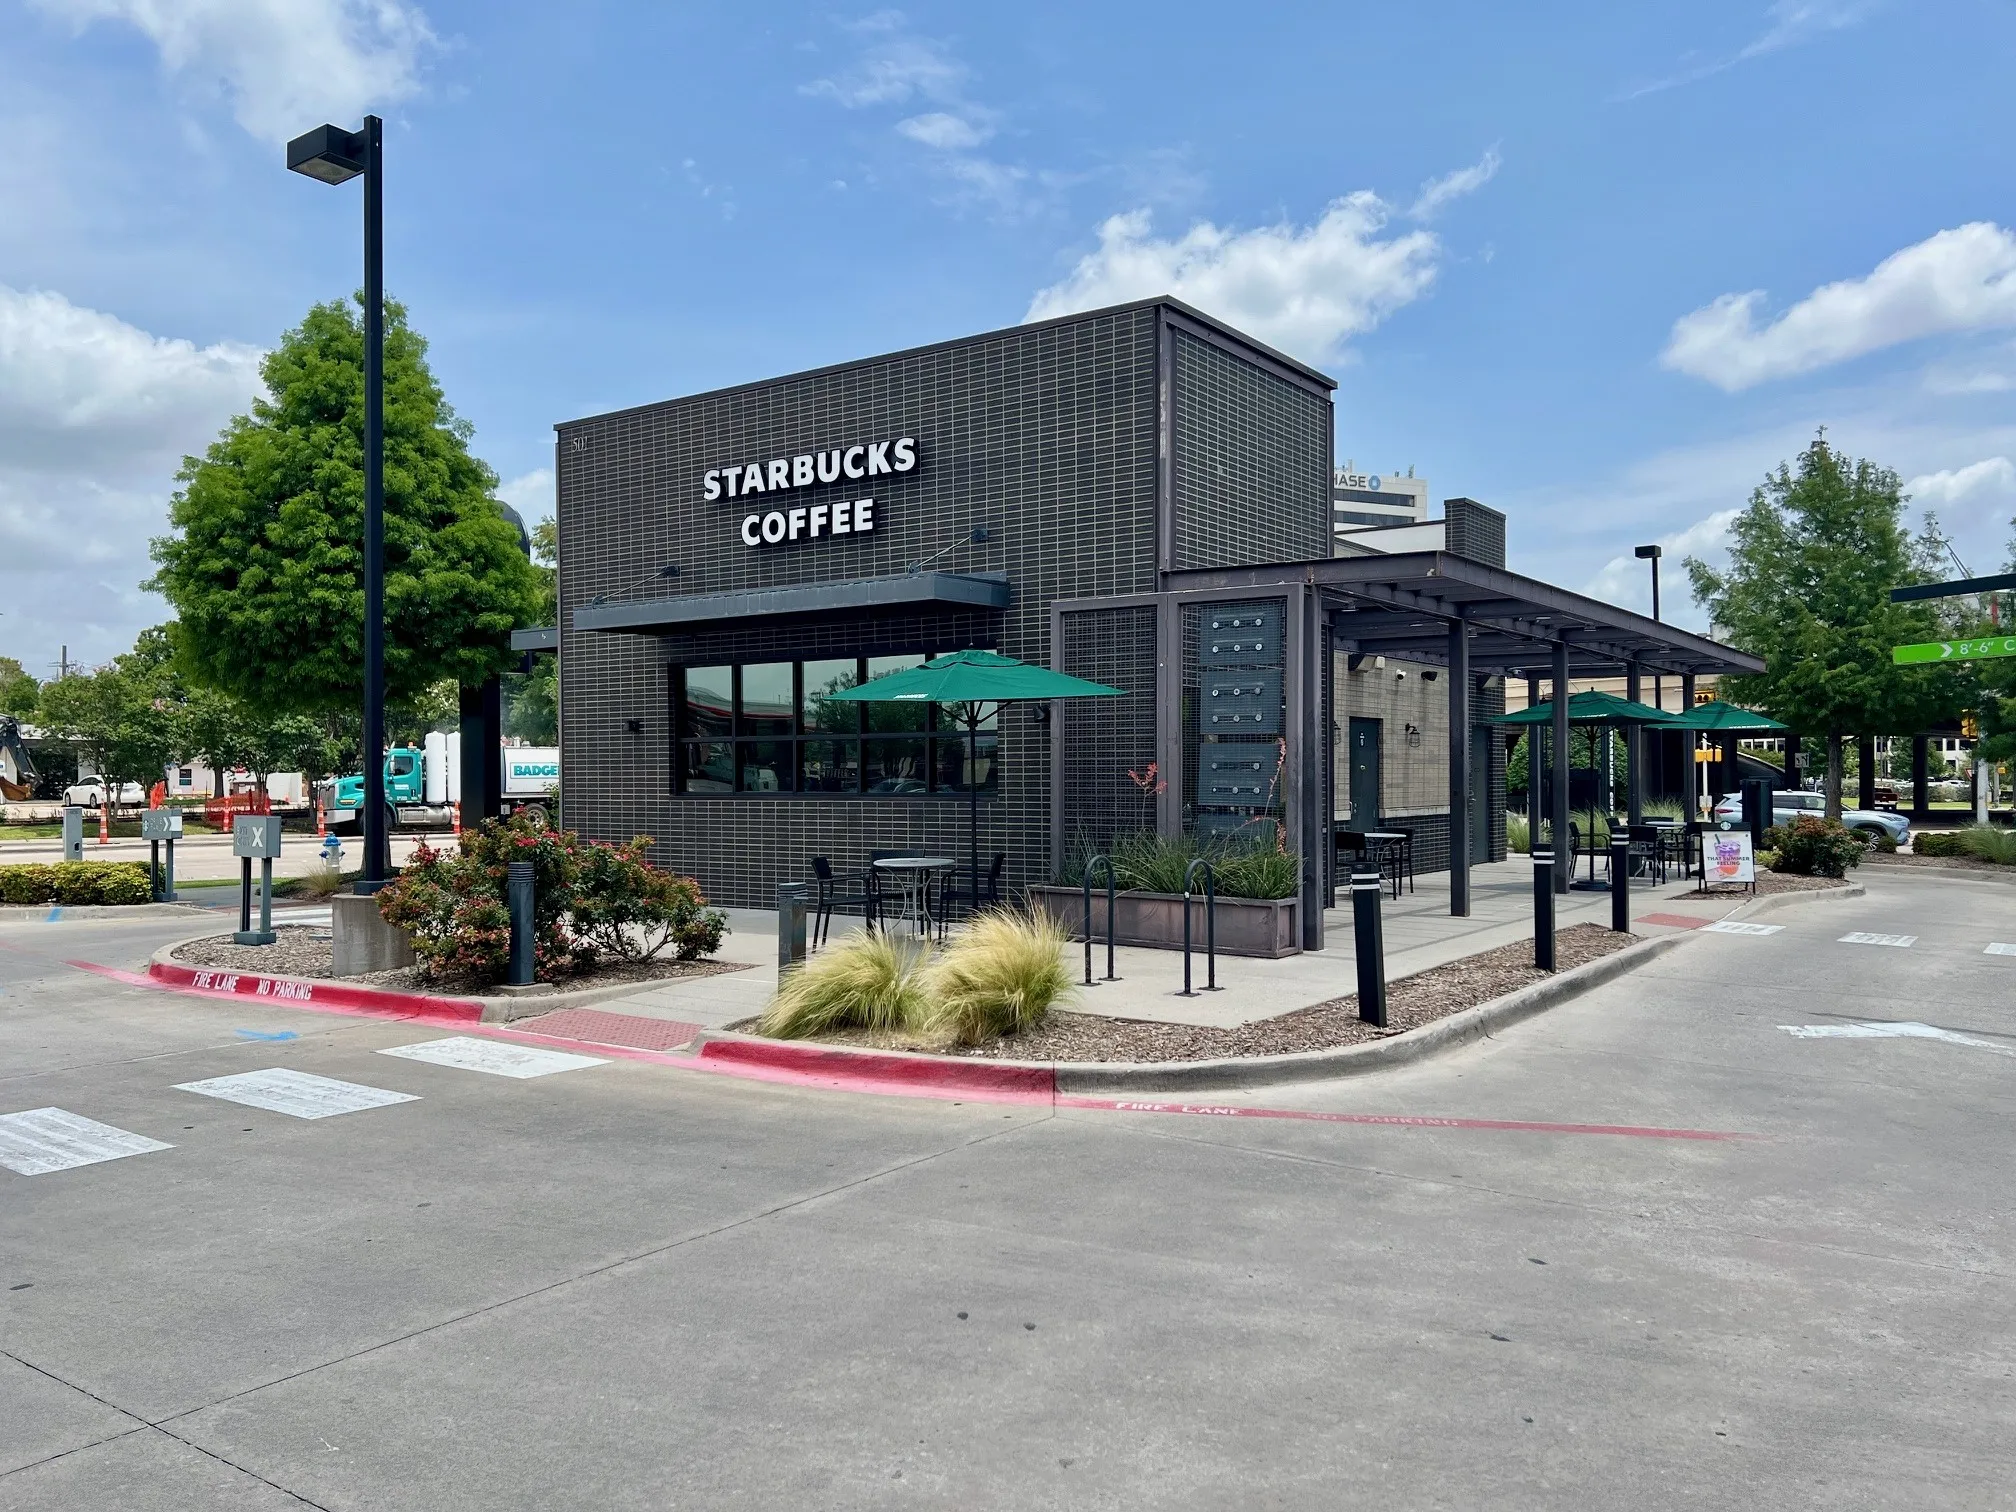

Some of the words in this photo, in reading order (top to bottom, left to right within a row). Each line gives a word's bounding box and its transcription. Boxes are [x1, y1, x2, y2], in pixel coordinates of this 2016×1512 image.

[572, 435, 588, 453] 501
[703, 437, 916, 500] STARBUCKS
[741, 498, 873, 546] COFFEE
[513, 764, 559, 776] BADGE
[192, 971, 214, 989] FIRE
[214, 973, 240, 993] LANE
[256, 979, 271, 996] NO
[272, 981, 313, 1001] PARKING
[1115, 1101, 1168, 1111] FIRE
[1181, 1104, 1244, 1116] LANE
